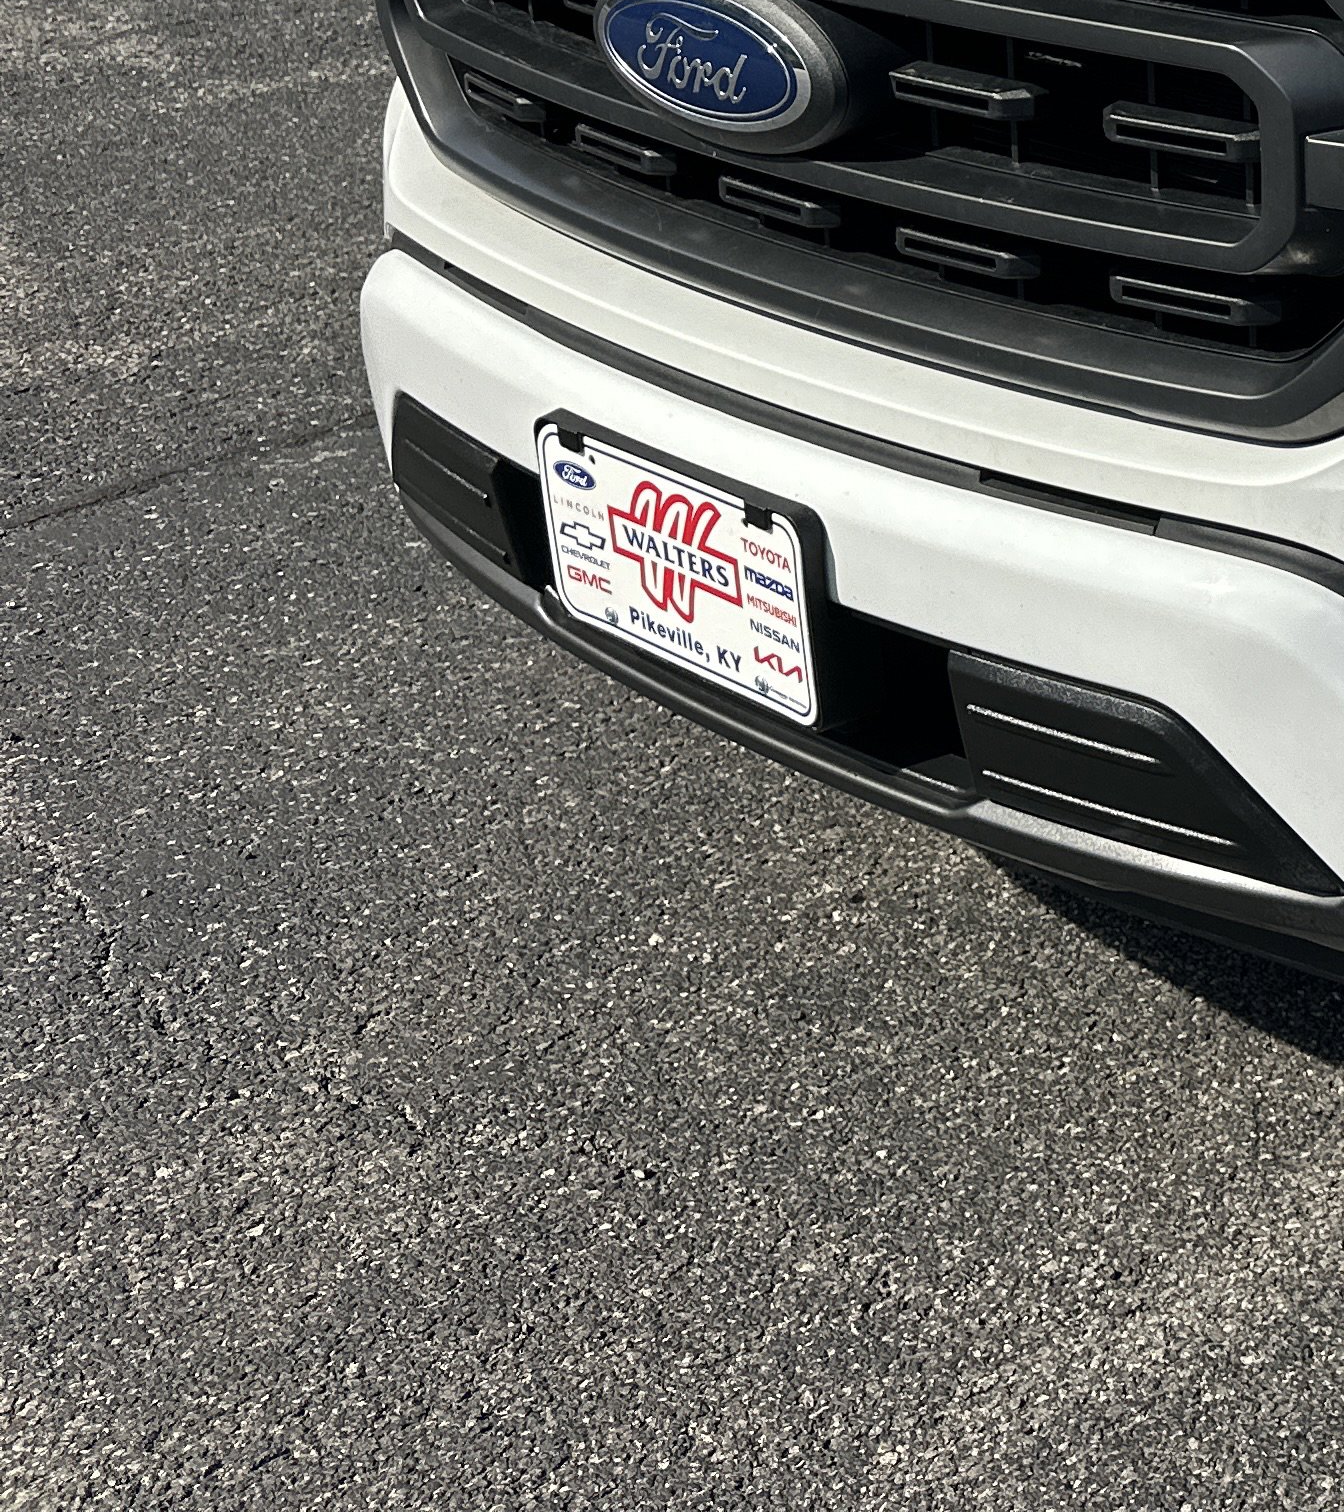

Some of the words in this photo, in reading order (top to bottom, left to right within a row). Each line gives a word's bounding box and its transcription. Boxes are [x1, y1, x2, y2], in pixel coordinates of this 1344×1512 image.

[637, 12, 748, 104] Ford
[562, 464, 588, 487] Ford
[553, 494, 605, 521] LINCOLN
[561, 544, 611, 570] CHEVROLET
[622, 524, 730, 587] WALTERS
[740, 537, 791, 573] TOYOTA
[567, 564, 612, 595] GMC
[747, 593, 797, 627] MITSUBISHI
[628, 605, 711, 662] Pikeville,
[716, 645, 742, 673] KY
[750, 618, 800, 653] NISSAN
